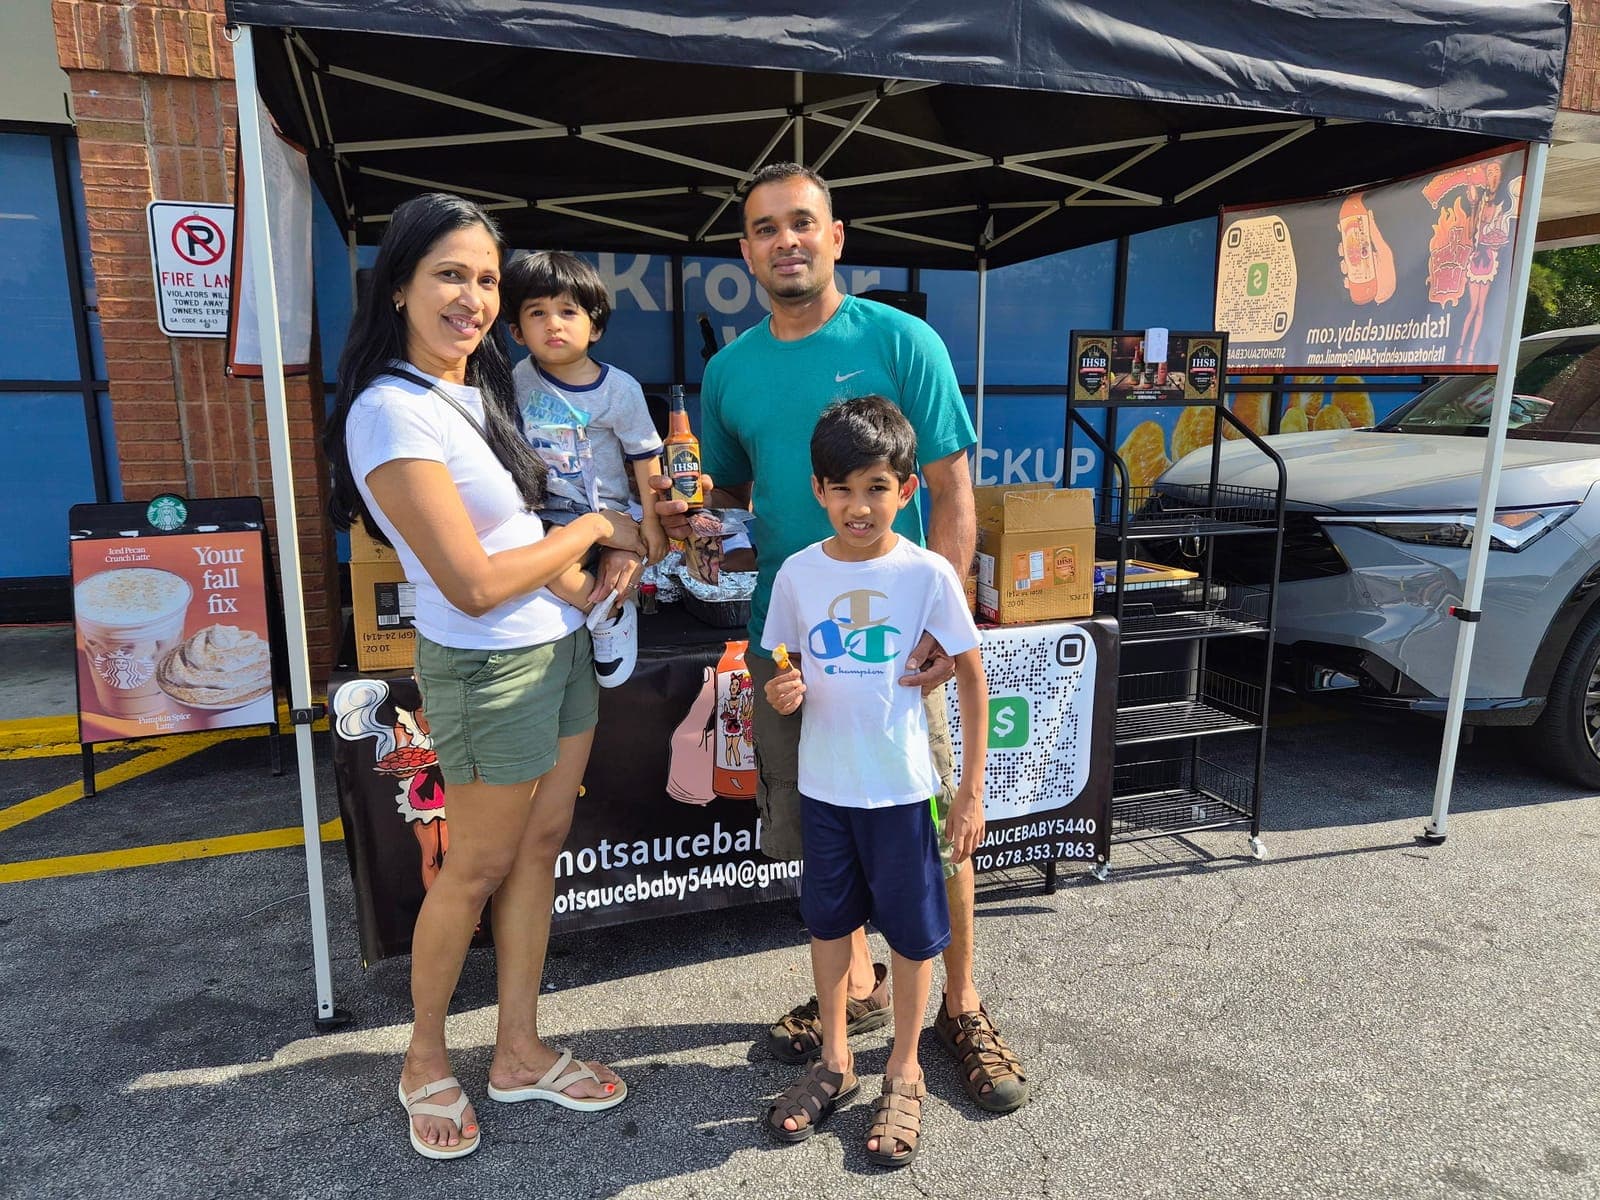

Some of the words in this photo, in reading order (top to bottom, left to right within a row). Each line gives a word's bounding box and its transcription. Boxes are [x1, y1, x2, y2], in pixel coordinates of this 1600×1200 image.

[162, 272, 194, 287] FIRE
[598, 253, 880, 314] Kror
[167, 290, 208, 298] VIOLATORS
[175, 299, 199, 307] TOWED
[1082, 358, 1107, 368] IHSB
[1192, 358, 1216, 368] IHSB
[673, 462, 699, 472] IHSB
[968, 447, 1096, 486] CKUP
[105, 554, 131, 563] Crunch
[192, 546, 245, 567] Your
[203, 568, 239, 590] fall
[207, 594, 239, 615] fix
[363, 632, 396, 641] 24-414)
[379, 644, 389, 653] 10
[824, 664, 884, 677] Champion
[138, 714, 171, 725] Pumpkin
[172, 713, 192, 722] Spice
[975, 854, 993, 871] TO
[995, 842, 1096, 868] 678.353.7863
[551, 859, 804, 915] otsaucebaby5440@gma
